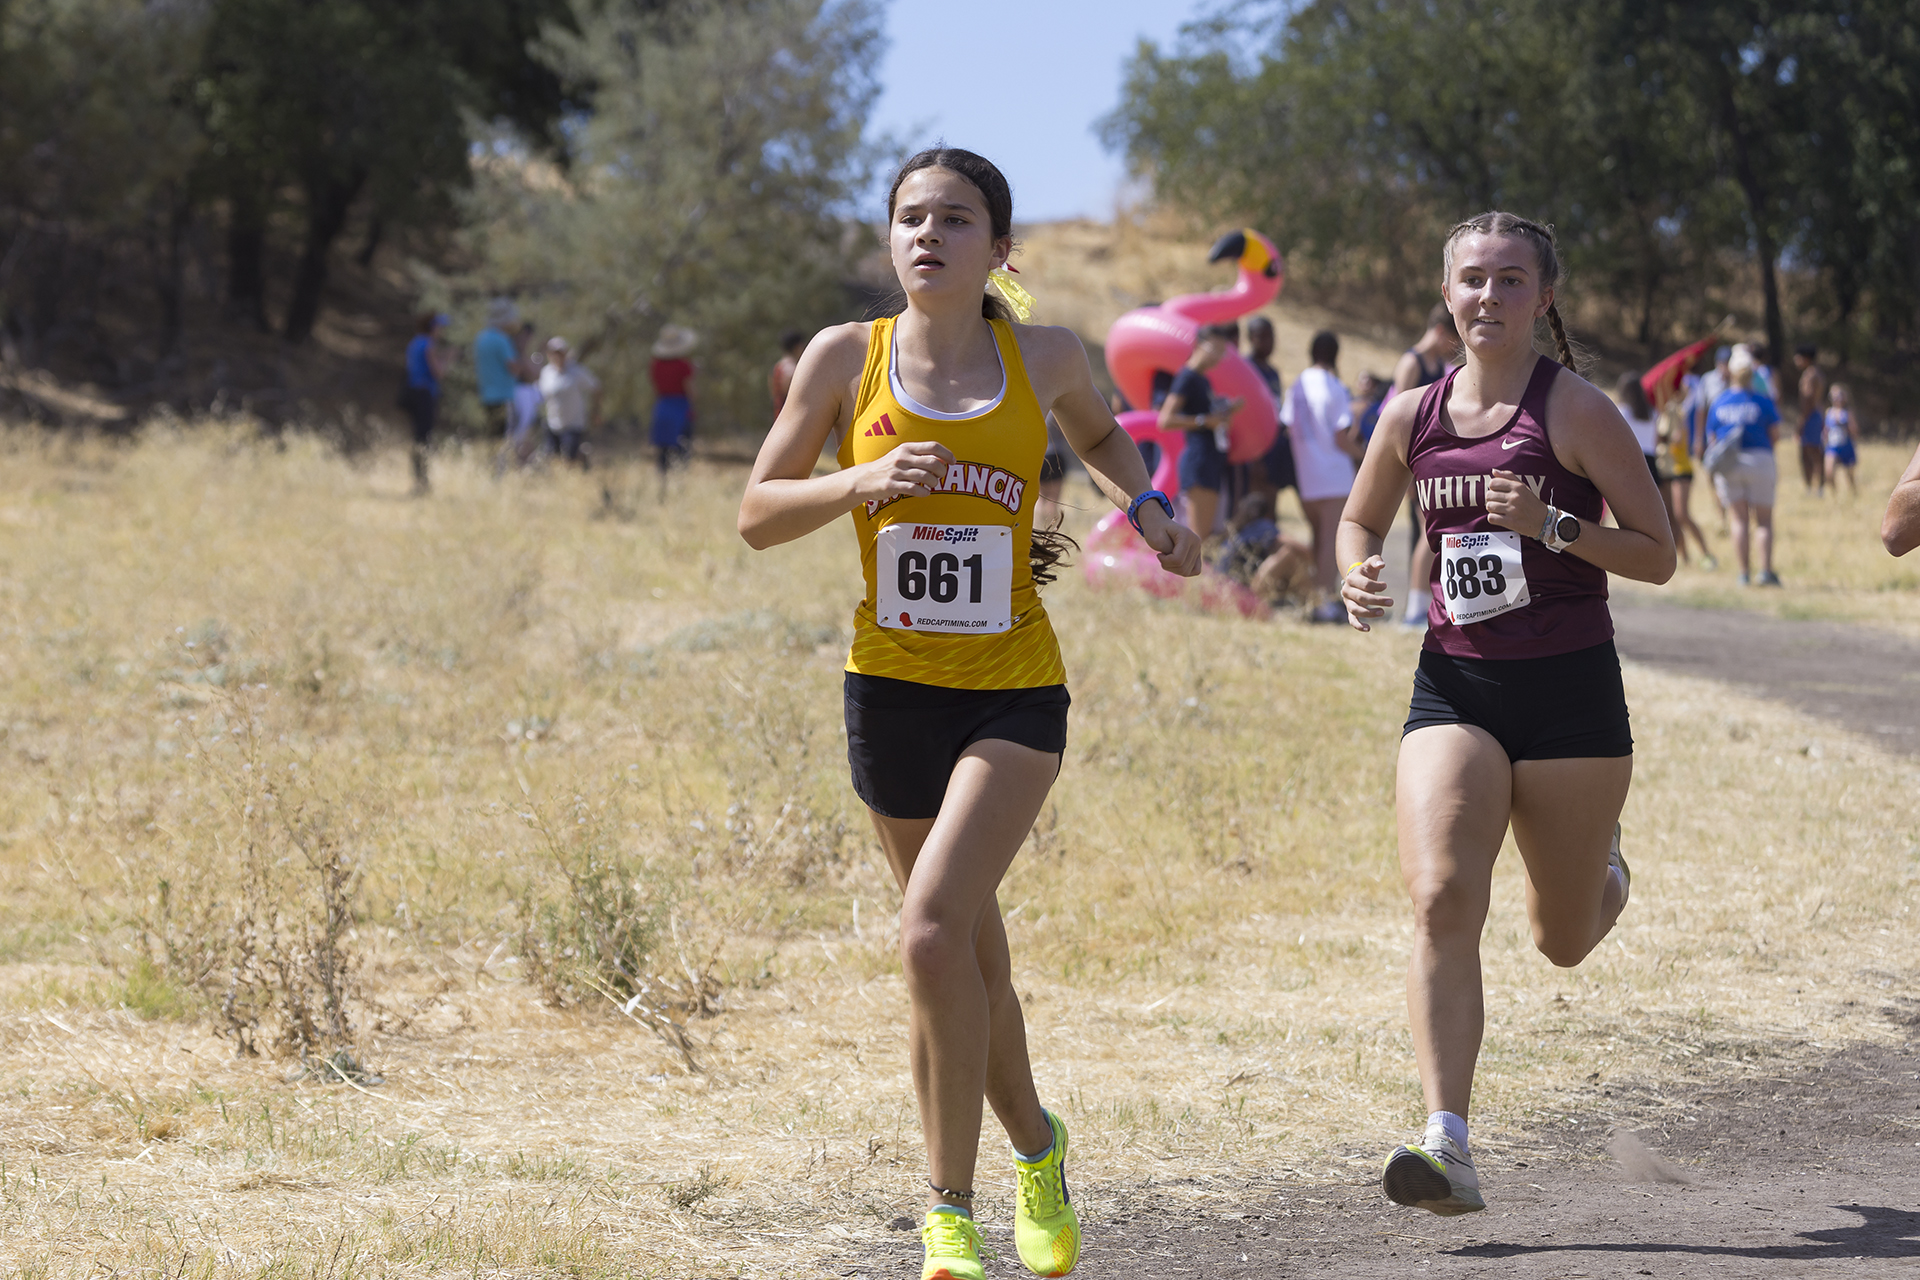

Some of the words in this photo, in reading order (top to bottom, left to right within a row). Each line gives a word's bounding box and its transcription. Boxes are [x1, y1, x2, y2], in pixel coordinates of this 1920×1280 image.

[903, 462, 1027, 514] ANCIS
[1416, 474, 1546, 511] WHITY
[912, 526, 978, 544] MileSplit
[1446, 534, 1490, 549] MileSplit
[898, 551, 982, 603] 661
[1447, 554, 1507, 600] 883
[917, 617, 987, 628] REDCAPTIMING.COM
